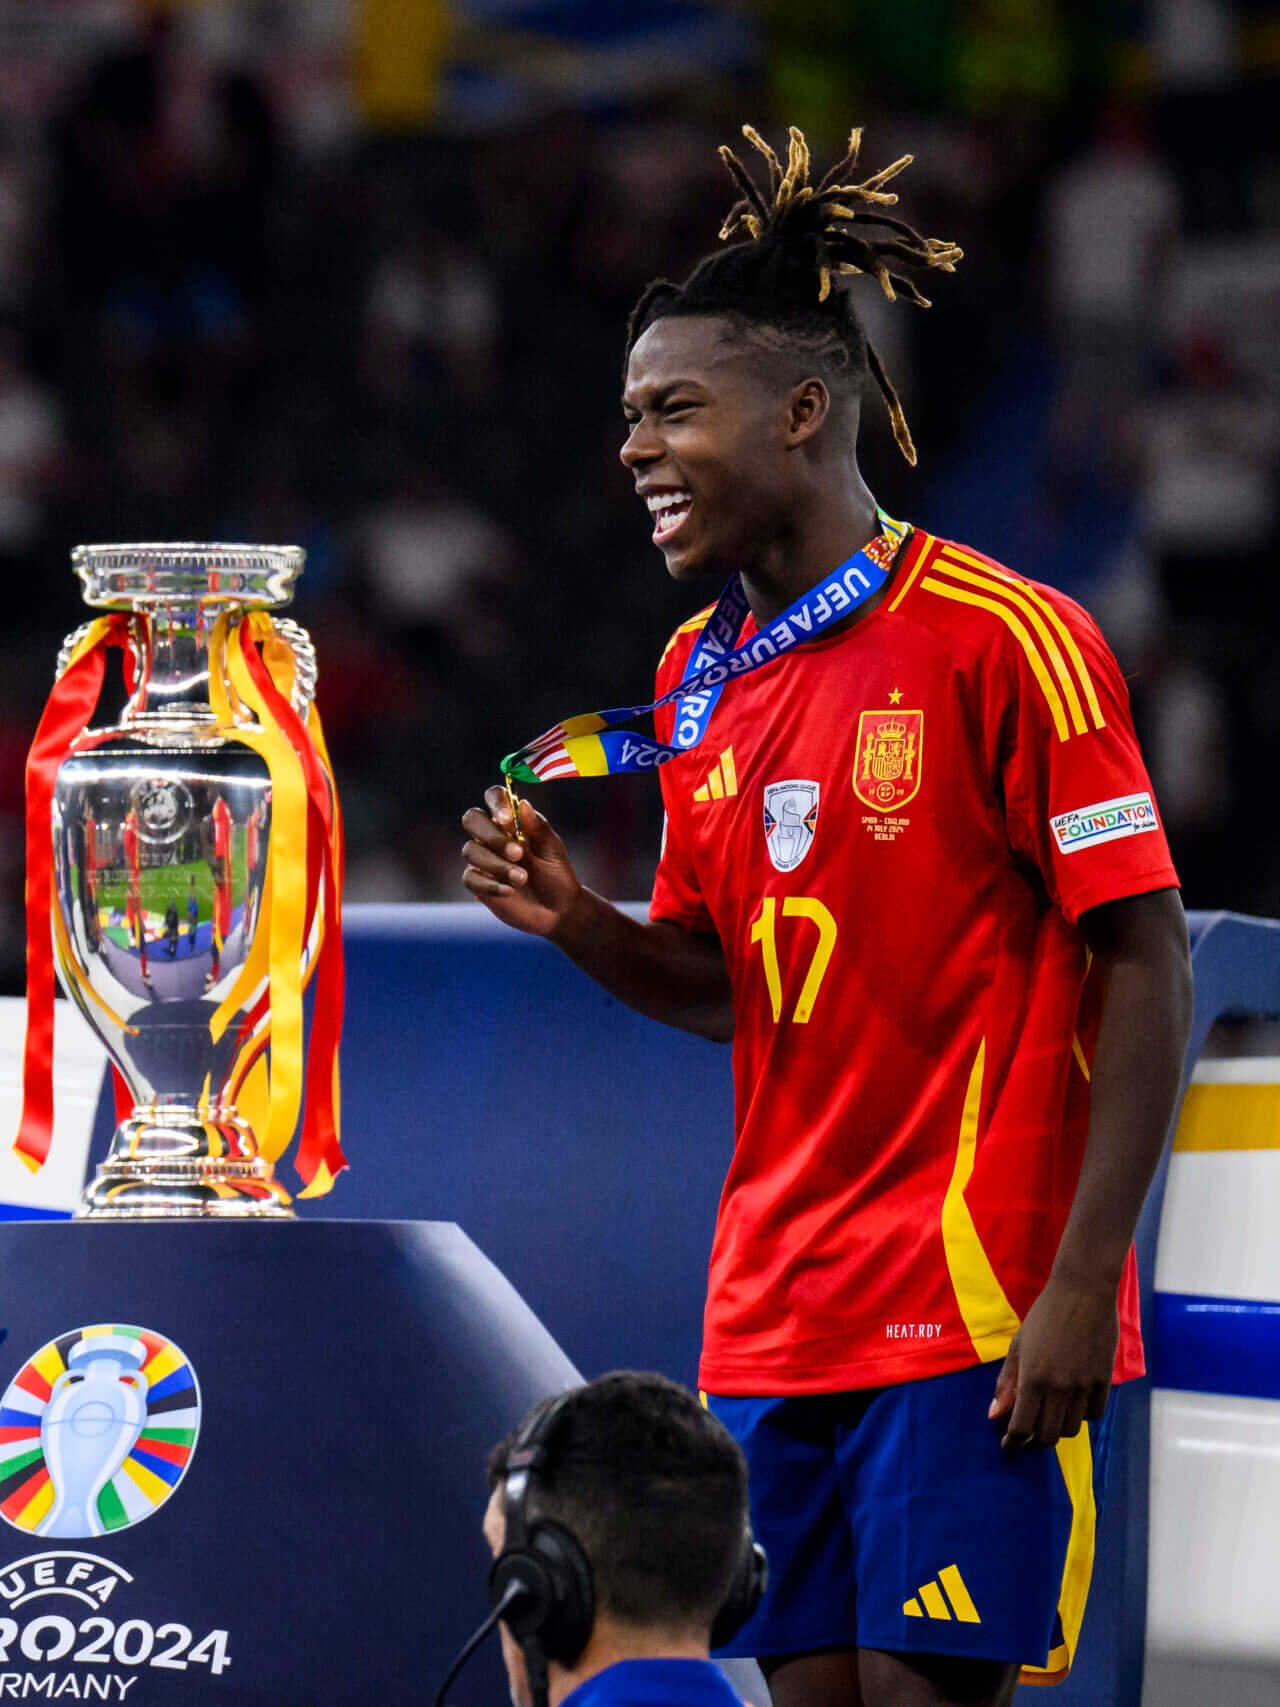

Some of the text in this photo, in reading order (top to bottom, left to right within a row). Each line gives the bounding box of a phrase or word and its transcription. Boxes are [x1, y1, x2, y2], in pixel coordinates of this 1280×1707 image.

[789, 567, 872, 632] UEFA
[1054, 813, 1080, 828] UEFA
[1057, 804, 1154, 842] FOUNDATION
[751, 897, 838, 1025] 17
[886, 1323, 942, 1339] HEAT.RDY
